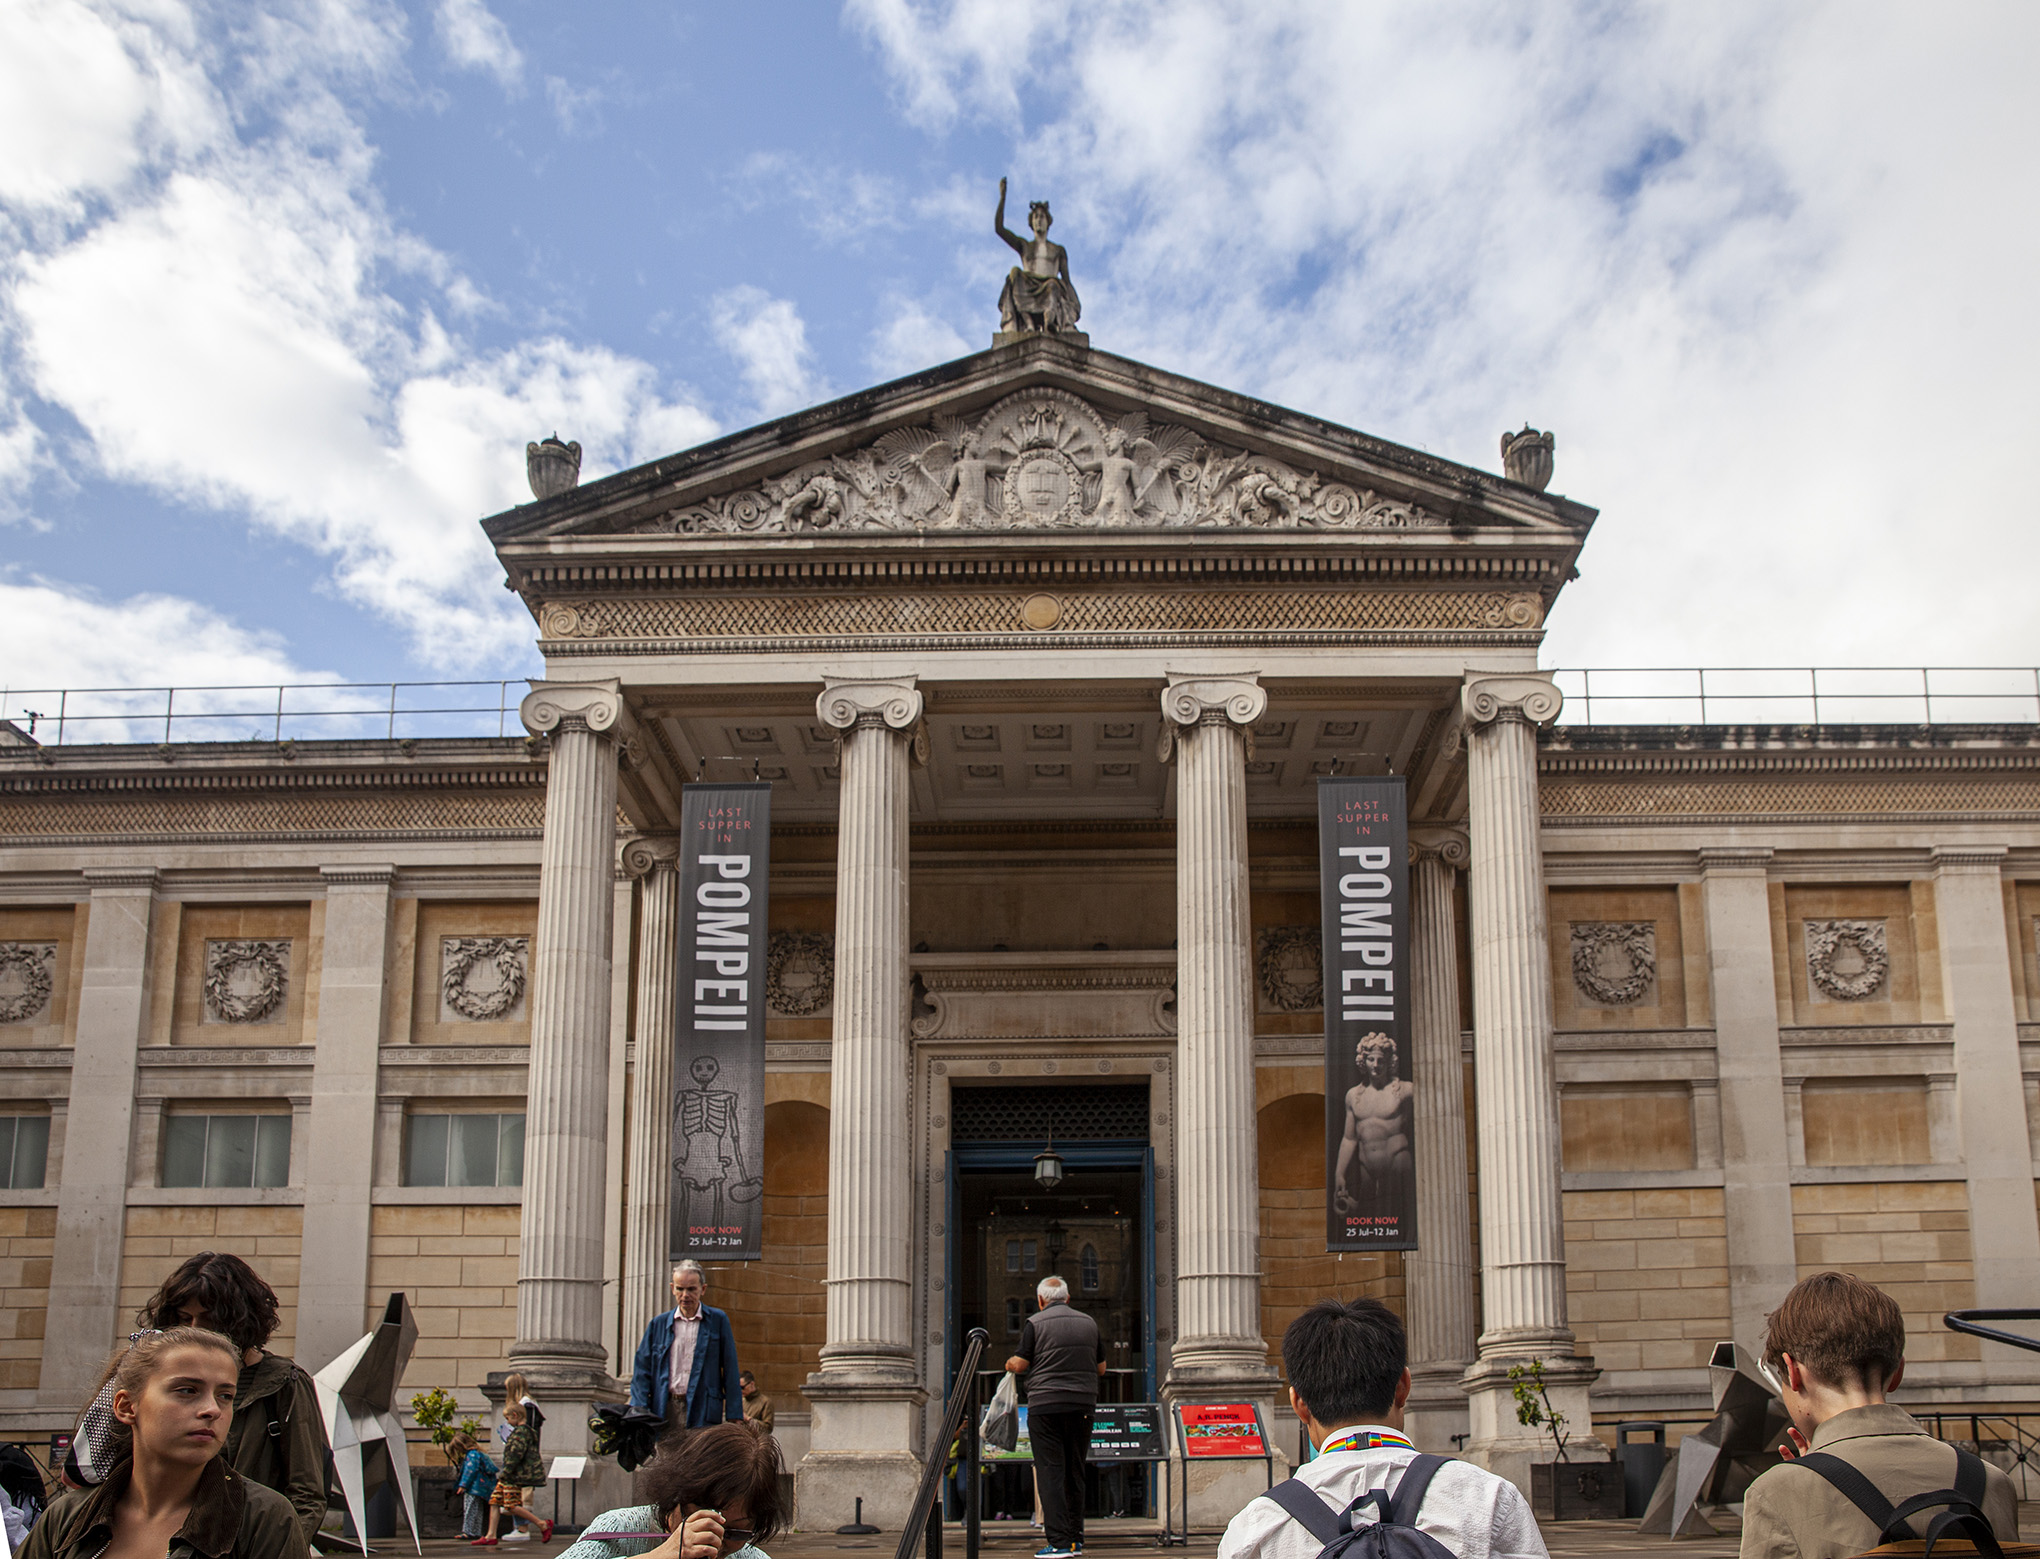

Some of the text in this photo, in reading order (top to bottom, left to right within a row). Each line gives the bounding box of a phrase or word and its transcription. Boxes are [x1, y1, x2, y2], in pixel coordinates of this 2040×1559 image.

[1345, 801, 1379, 810] LAST
[708, 808, 742, 817] LAST
[1337, 813, 1389, 823] SUPPER
[698, 820, 751, 830] SUPPER
[1356, 826, 1370, 835] IN
[717, 834, 731, 843] IN
[1338, 846, 1394, 1021] POMPEII
[694, 855, 751, 1030] POMPEII
[1346, 1216, 1399, 1225] BOOK NOW
[689, 1226, 743, 1234] BOOK NOW
[1346, 1228, 1357, 1237] 25
[1385, 1227, 1399, 1236] Jan
[689, 1237, 700, 1246] 25
[729, 1237, 743, 1246] Jan
